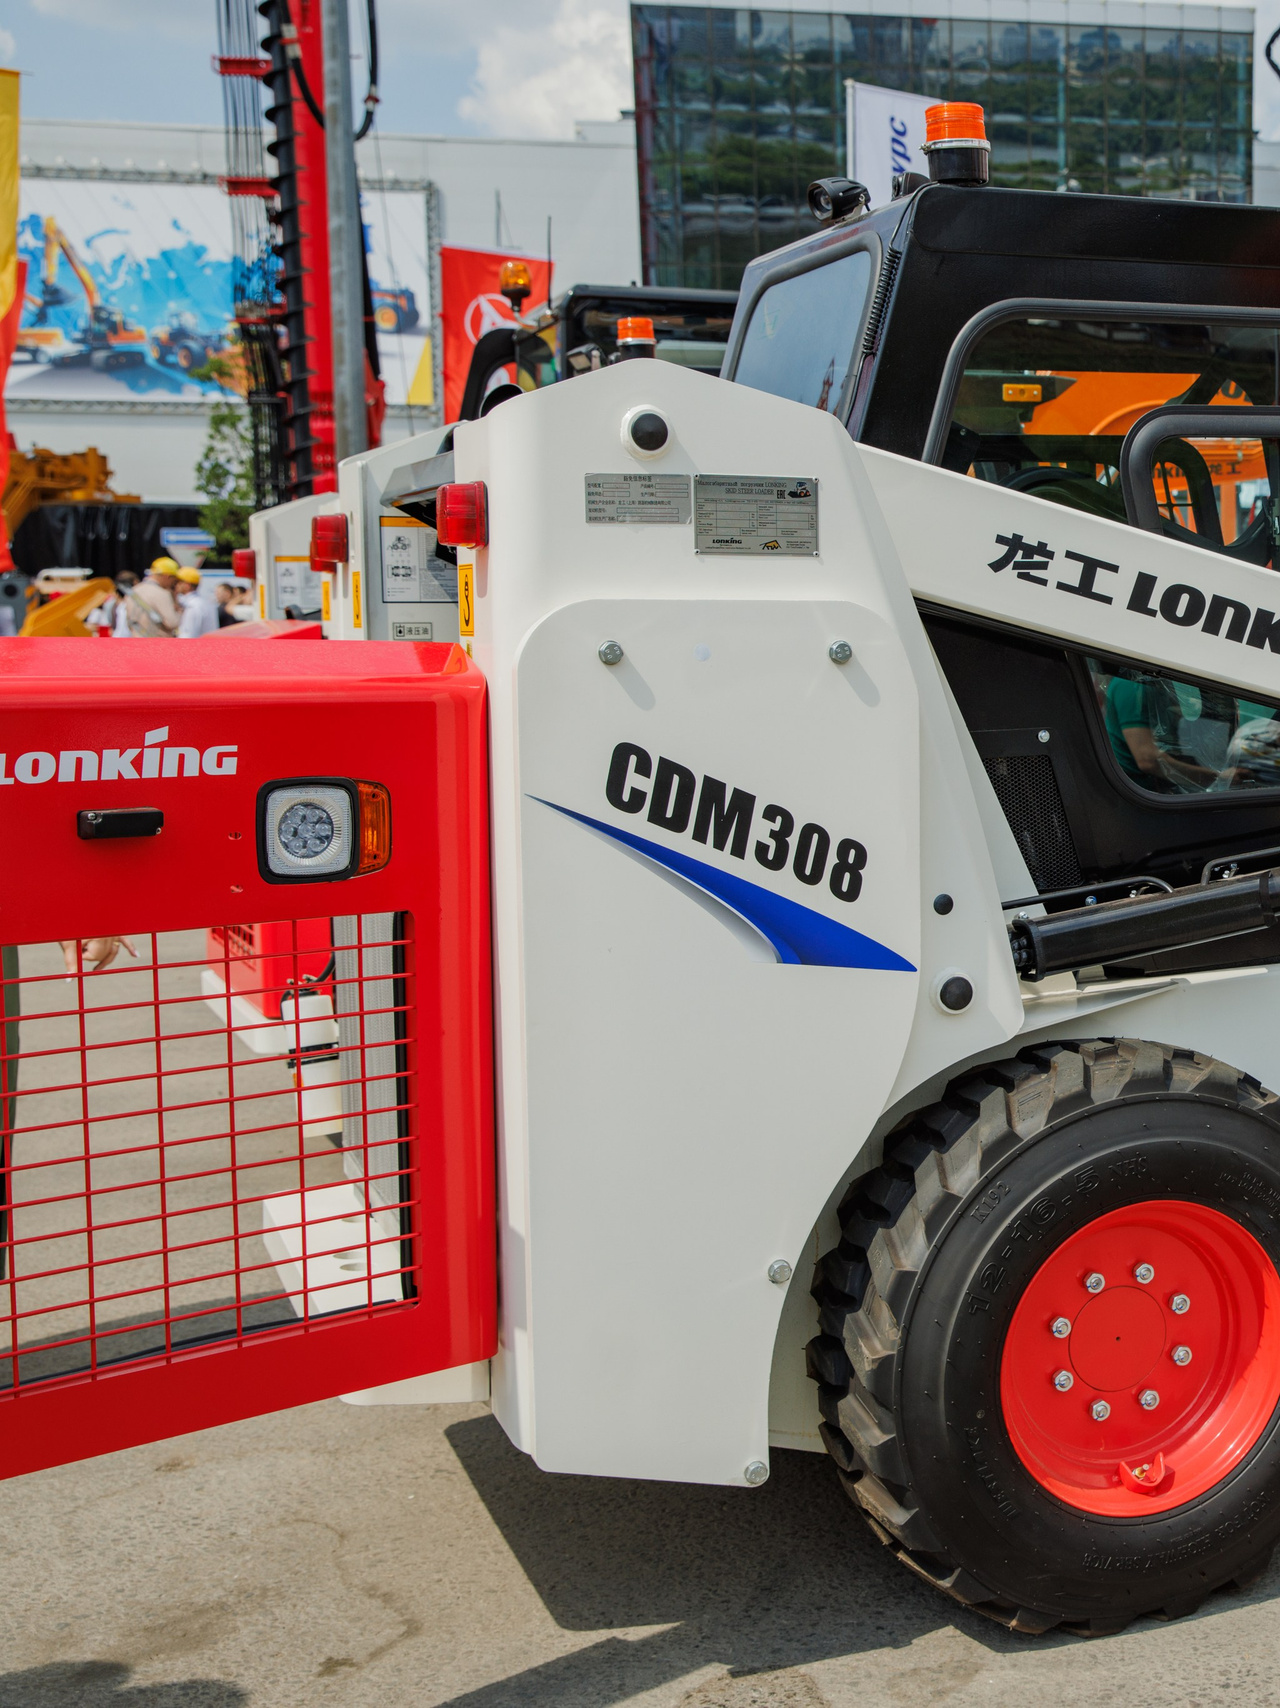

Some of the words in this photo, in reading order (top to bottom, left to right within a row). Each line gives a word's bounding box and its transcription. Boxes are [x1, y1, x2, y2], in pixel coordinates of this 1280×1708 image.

[987, 532, 1120, 606] 龙工
[0, 726, 238, 785] LONKING
[605, 741, 868, 903] CDM308
[970, 1180, 1012, 1224] K192
